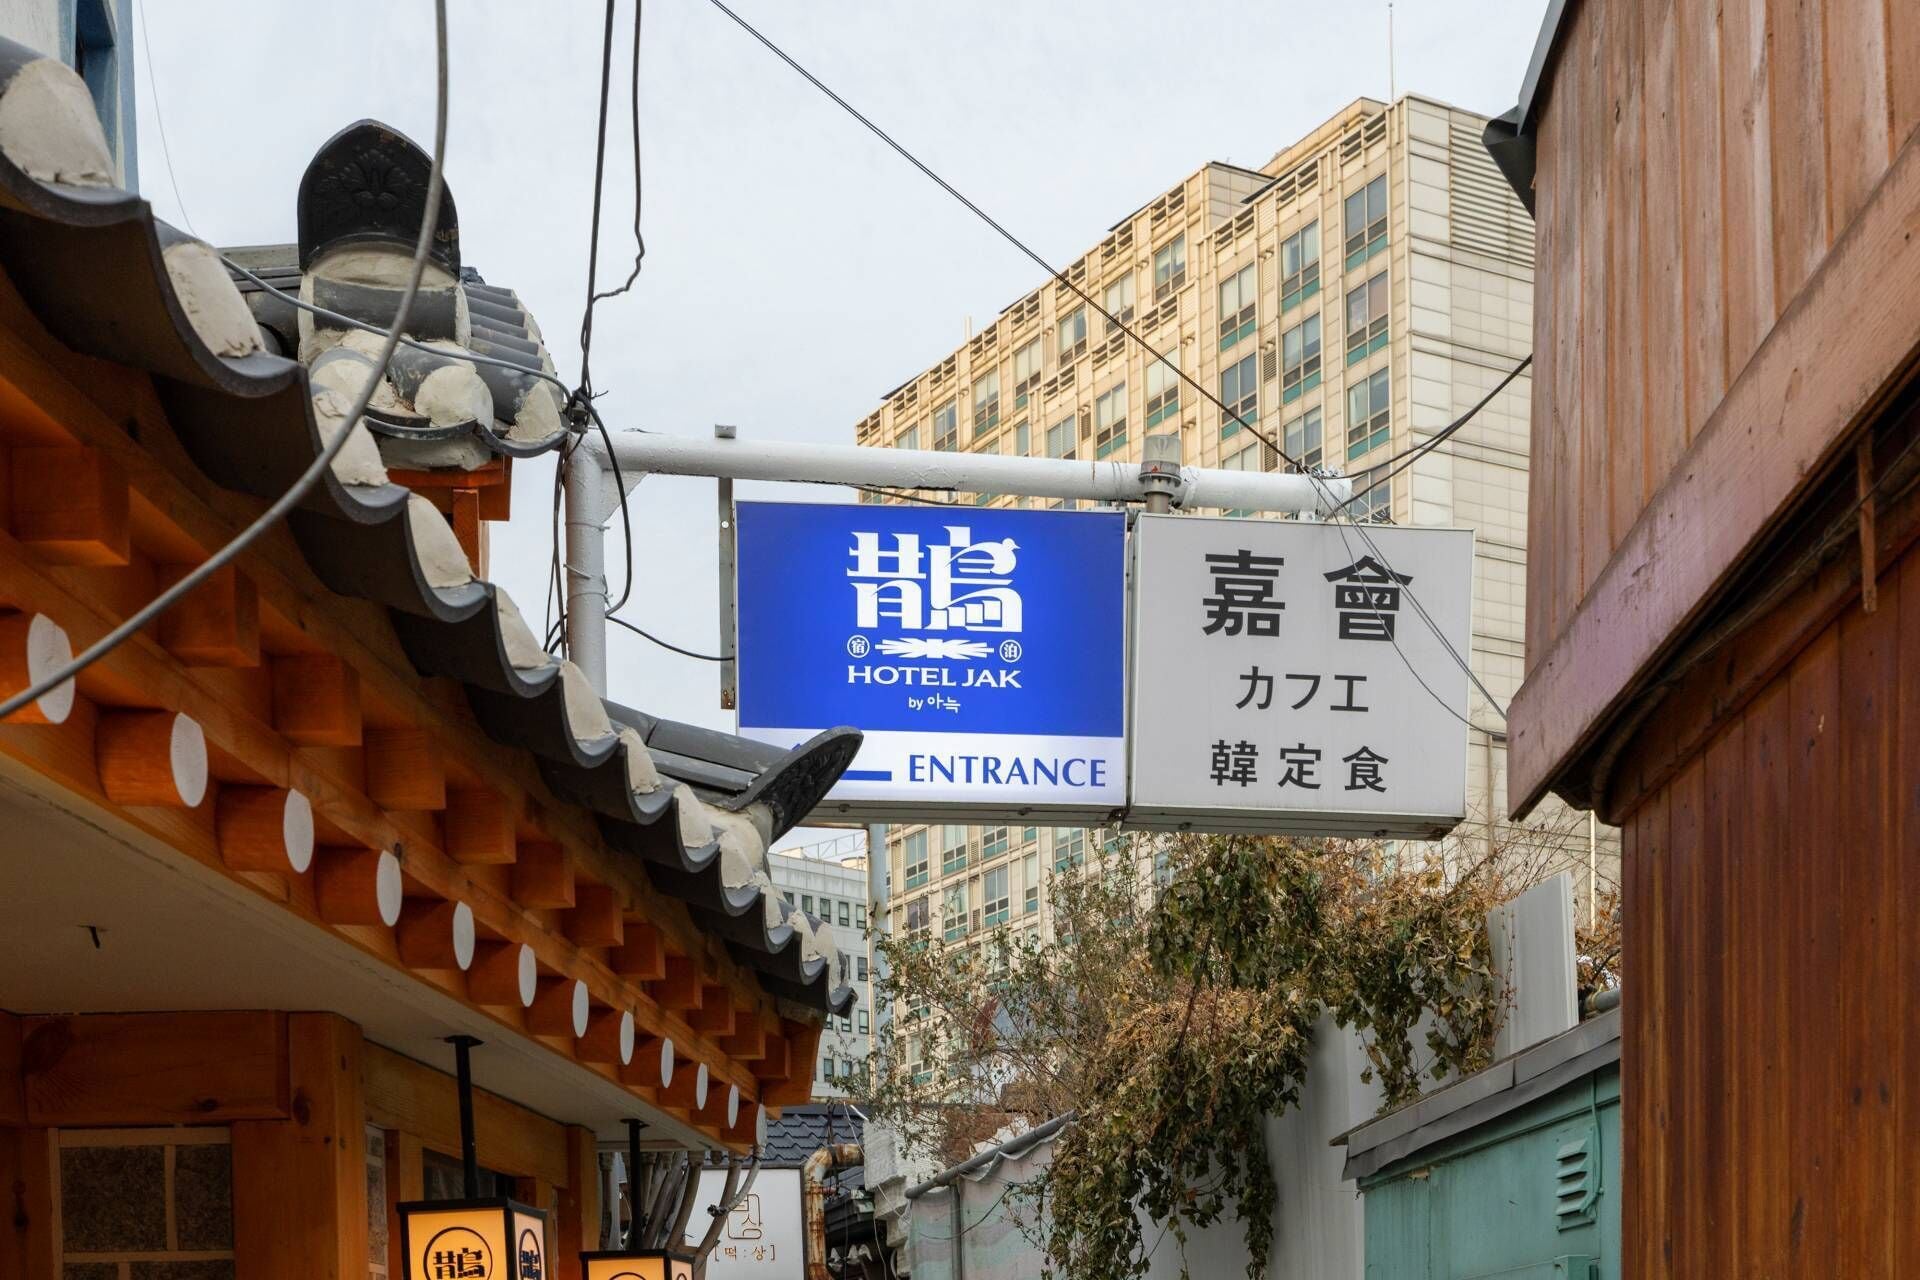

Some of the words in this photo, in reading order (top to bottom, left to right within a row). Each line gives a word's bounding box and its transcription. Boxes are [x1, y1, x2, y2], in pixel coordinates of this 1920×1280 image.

[1202, 549, 1414, 641] 嘉會
[1002, 642, 1020, 661] 泊
[848, 665, 956, 686] HOTEL
[962, 669, 1023, 688] JAK
[908, 697, 923, 711] by
[927, 693, 960, 713] 아늑
[909, 754, 1106, 787] ENTRANCE
[1210, 740, 1389, 793] 韓定食
